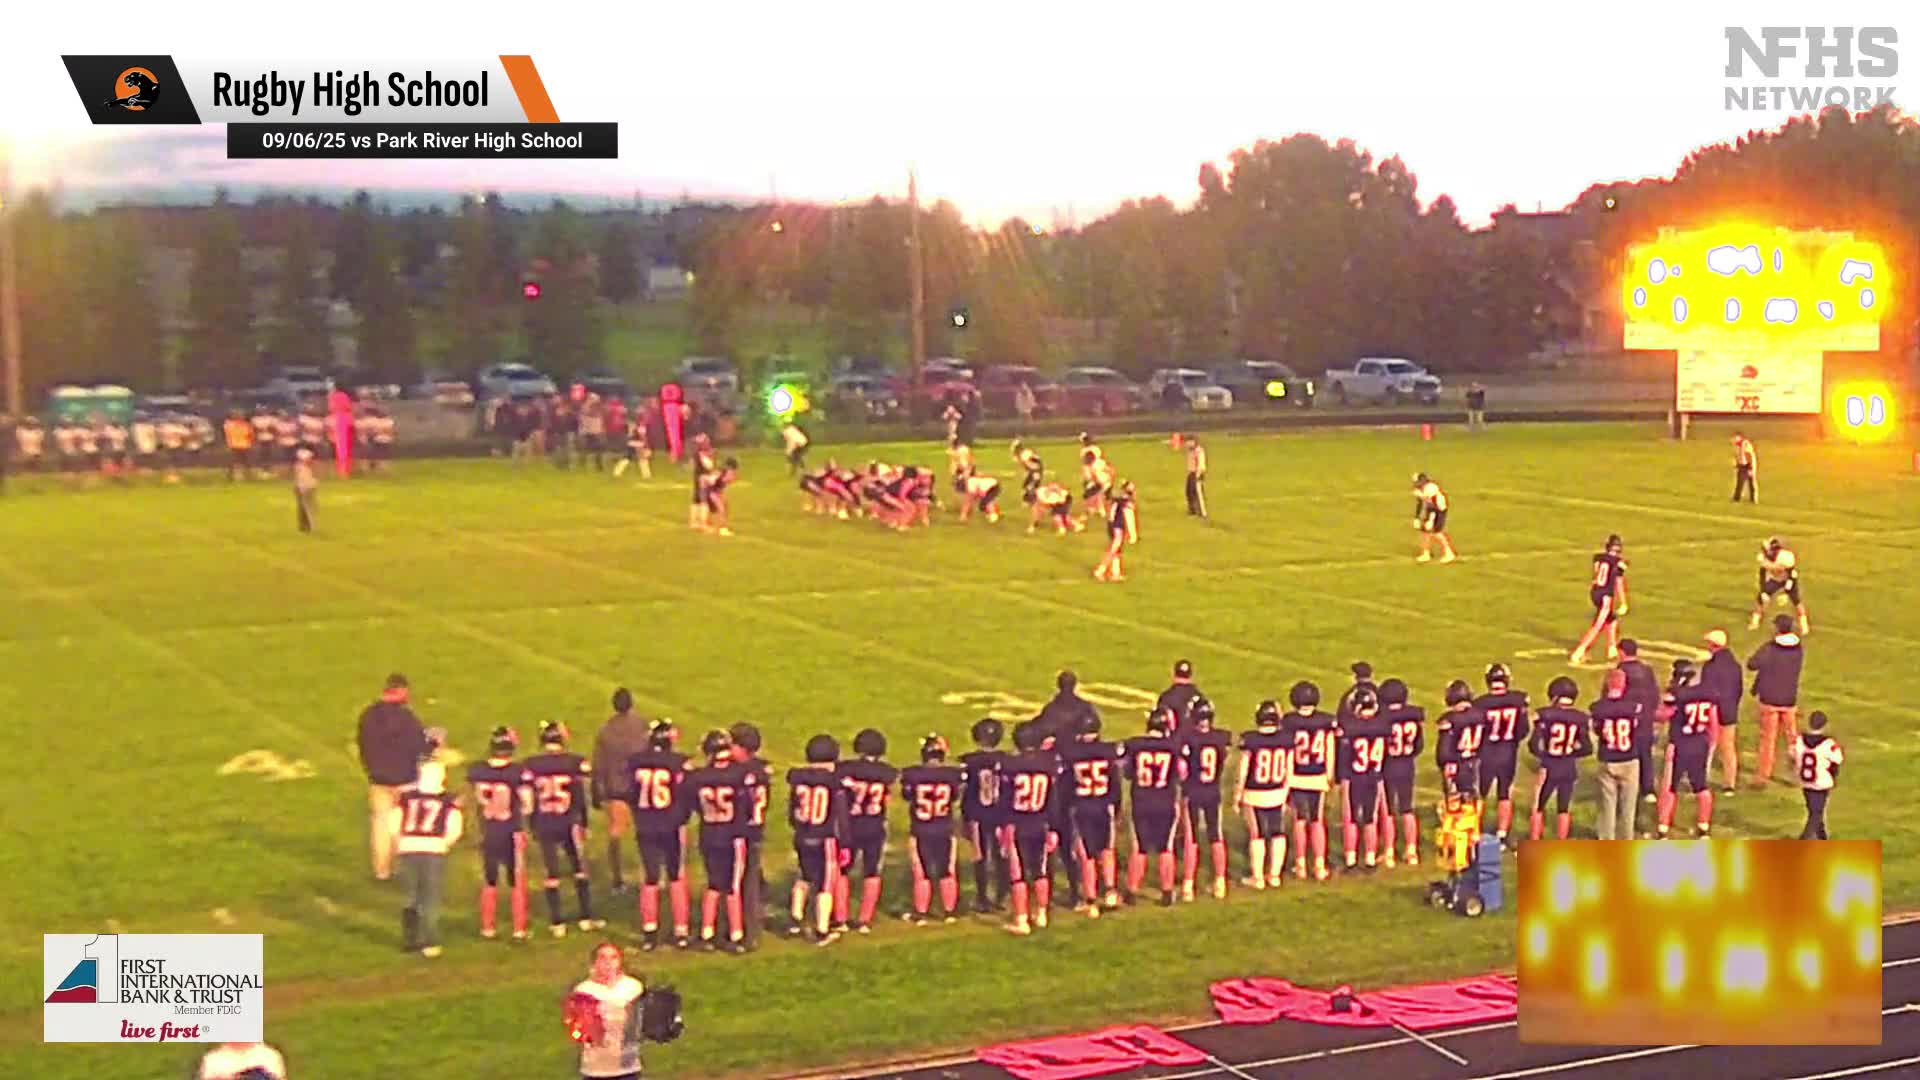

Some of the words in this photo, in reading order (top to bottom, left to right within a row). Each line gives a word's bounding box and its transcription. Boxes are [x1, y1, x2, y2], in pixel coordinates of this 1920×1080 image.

[1486, 708, 1518, 742] 77
[1199, 746, 1218, 783] 9
[1254, 748, 1287, 783] 80
[1294, 729, 1326, 765] 24
[1352, 737, 1385, 773] 34
[1072, 760, 1109, 797] 55
[1136, 751, 1172, 788] 67
[1800, 752, 1817, 782] 8
[634, 767, 672, 809] 76
[795, 784, 830, 825] 30
[915, 783, 952, 821] 52
[1013, 773, 1049, 812] 20
[405, 797, 442, 828] 17
